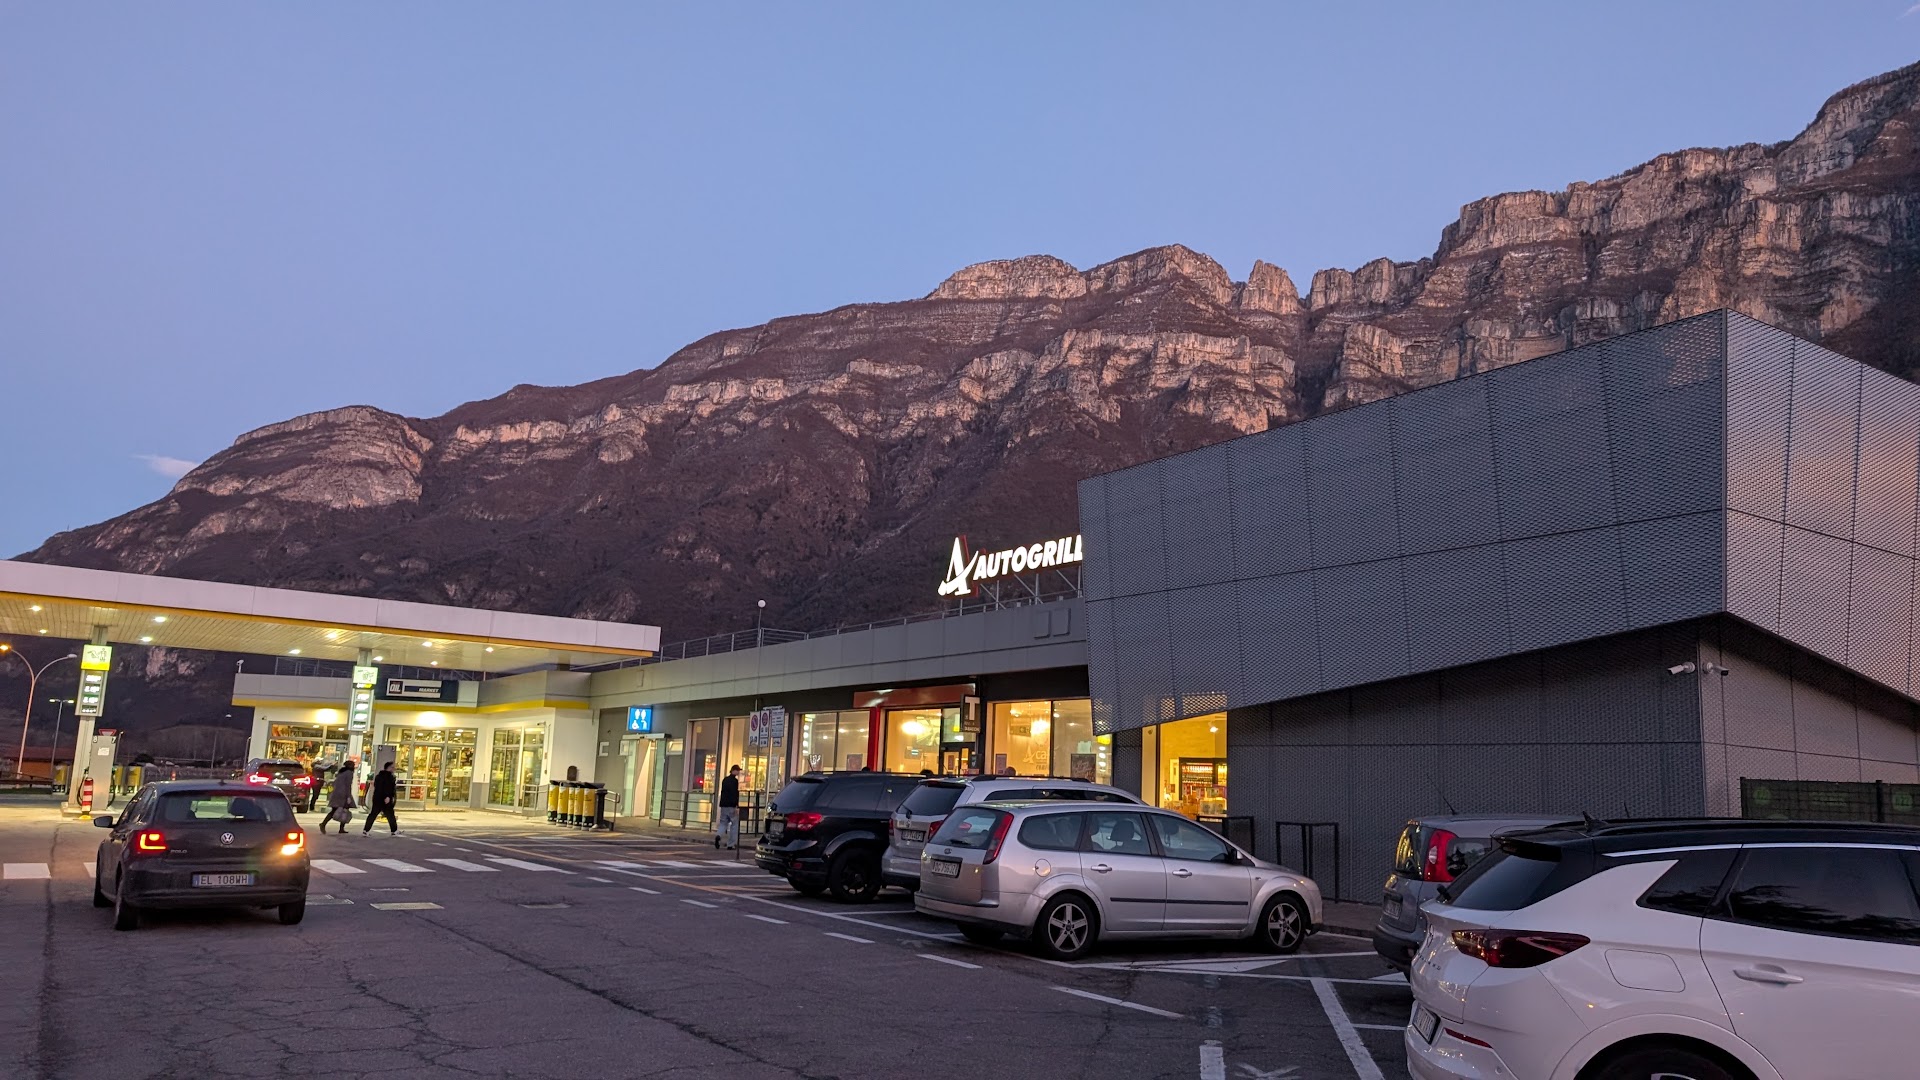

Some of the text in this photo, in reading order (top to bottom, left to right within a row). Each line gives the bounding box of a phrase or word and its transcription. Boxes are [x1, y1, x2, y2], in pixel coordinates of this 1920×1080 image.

[973, 534, 1083, 581] AUTOGRILL
[389, 683, 401, 692] OIL
[965, 696, 980, 720] T
[200, 874, 248, 885] EL 108WH
